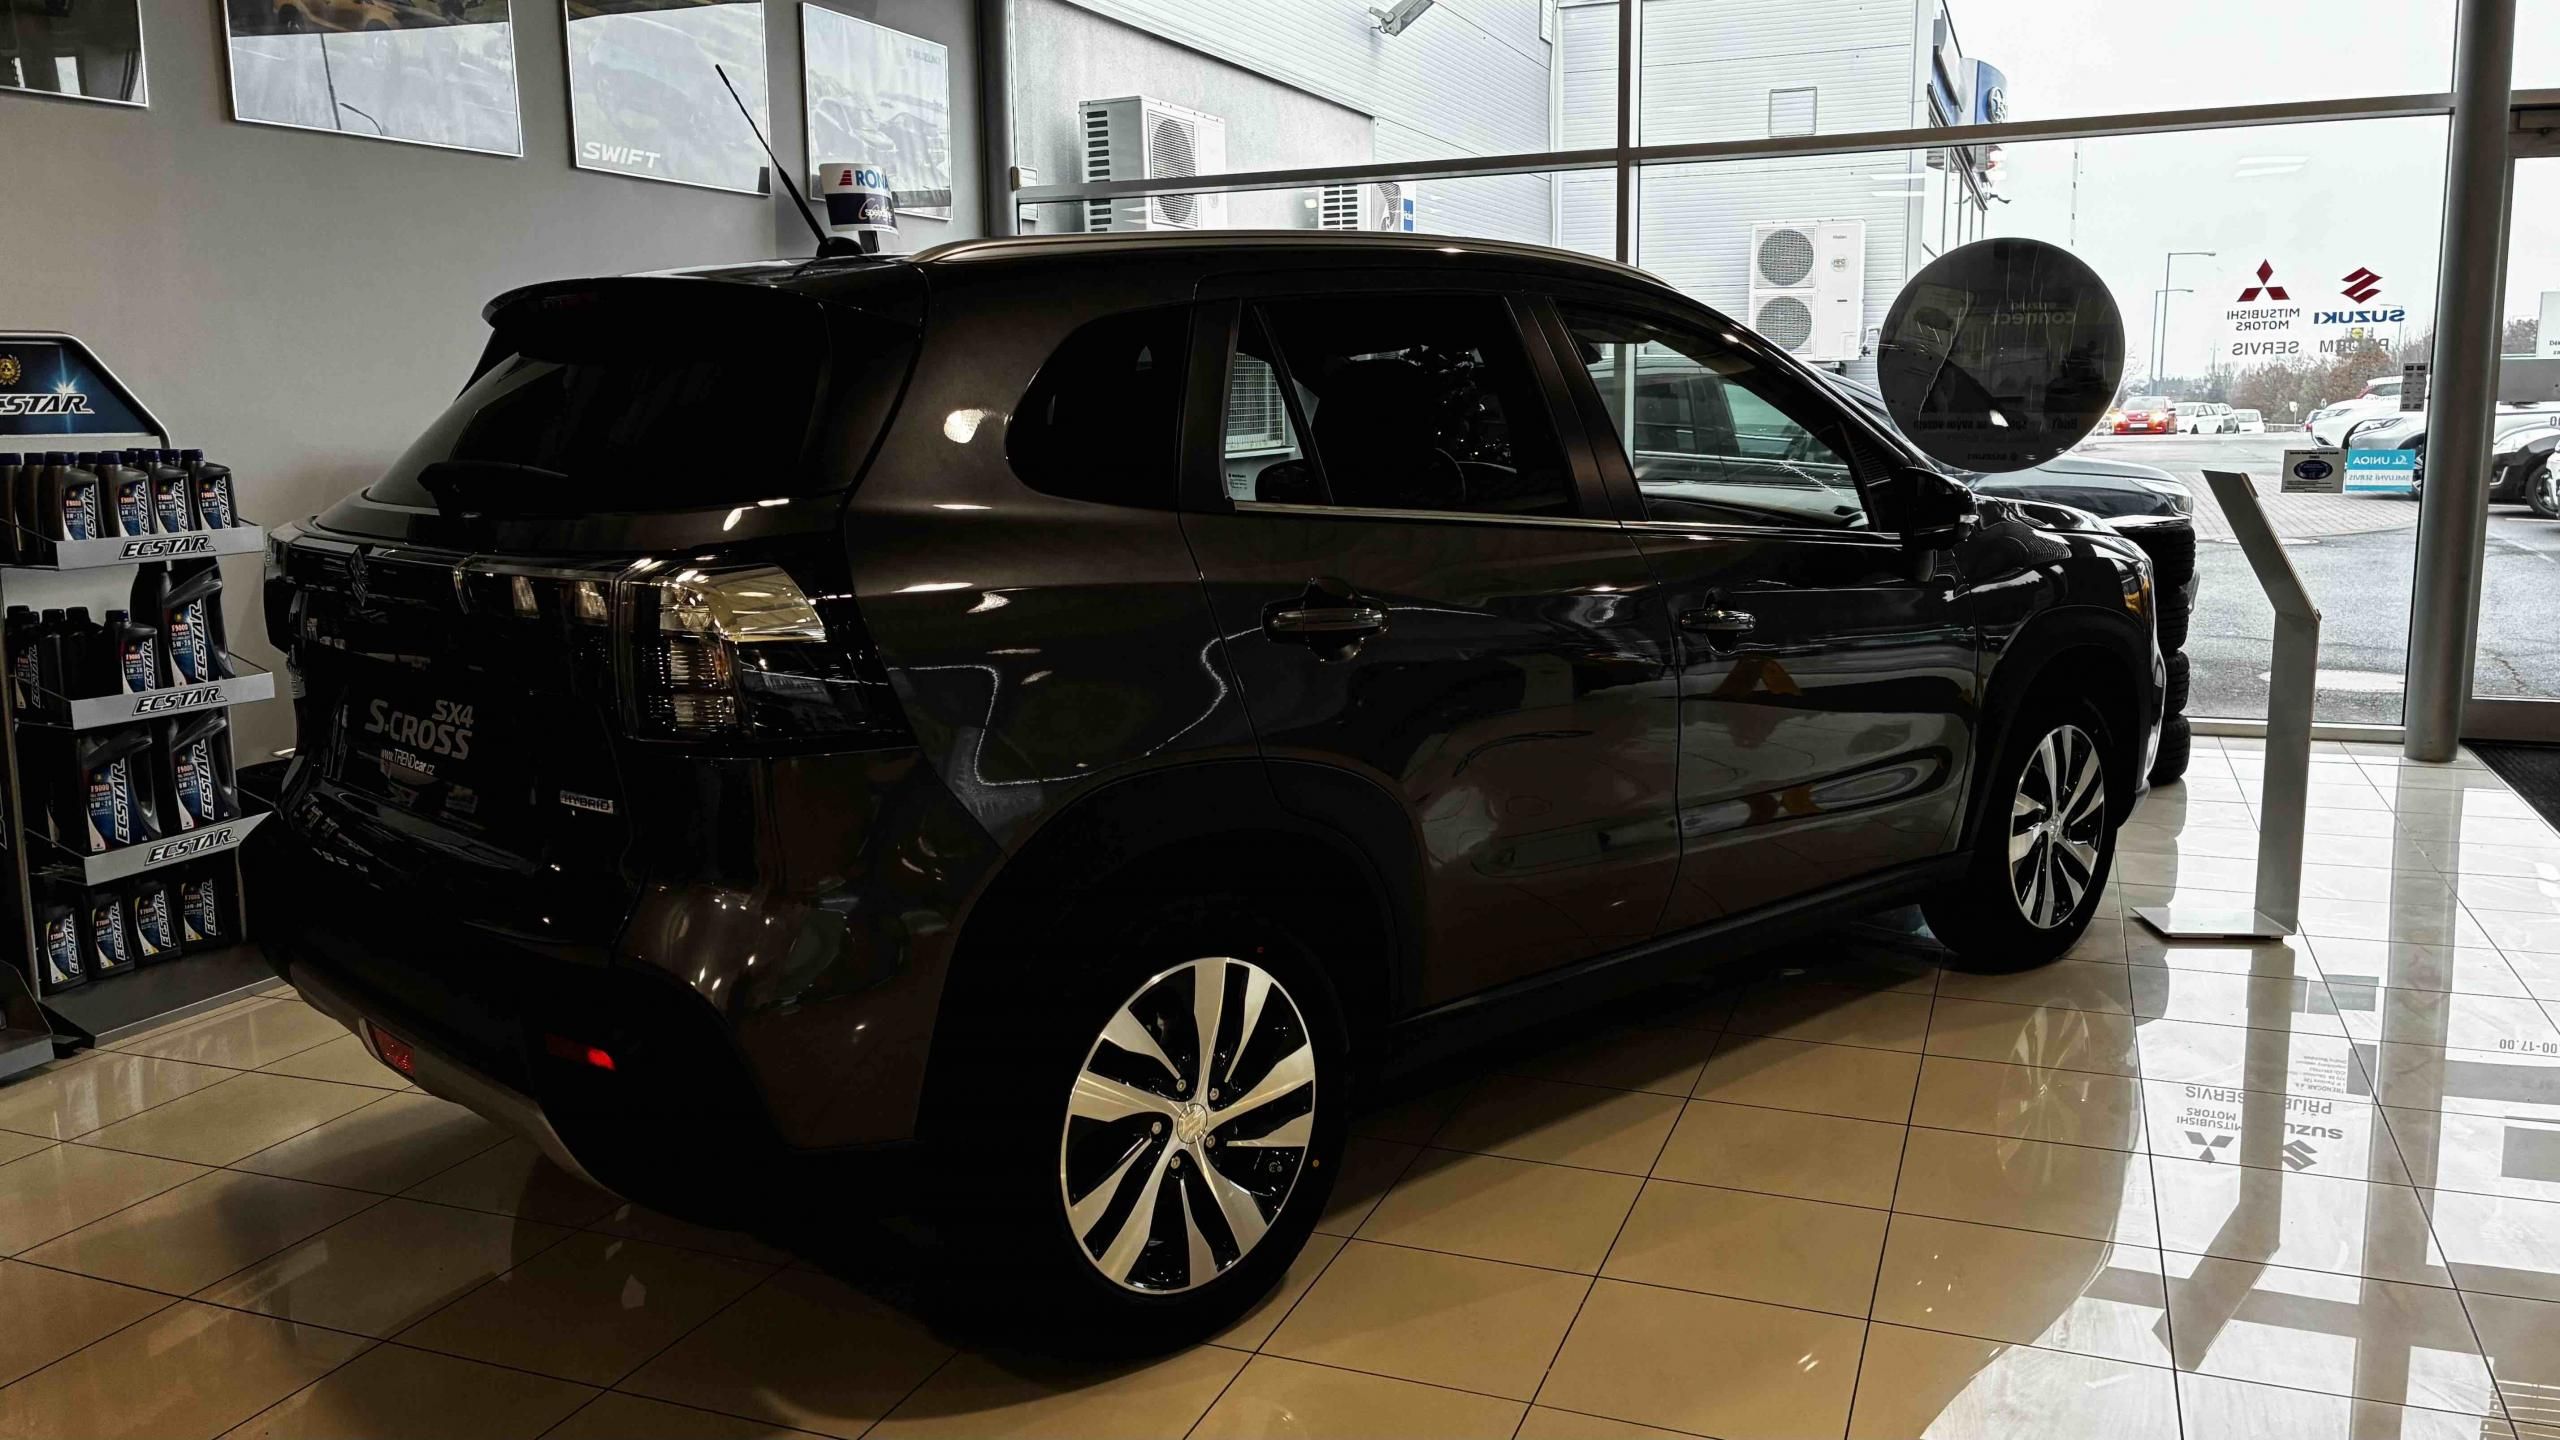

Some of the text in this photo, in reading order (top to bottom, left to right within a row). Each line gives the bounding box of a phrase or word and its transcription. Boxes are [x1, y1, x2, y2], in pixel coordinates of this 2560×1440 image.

[582, 141, 661, 169] SWIFT
[0, 393, 95, 415] STAR
[84, 483, 96, 540] CSTAR
[136, 481, 149, 536] CSTAR
[173, 479, 188, 532] CSTAR
[216, 475, 232, 529] CSTAR
[119, 535, 216, 560] ECSTAR
[188, 598, 208, 684] ECSTAR
[142, 638, 156, 692] CSTAR
[133, 686, 227, 716] ECSTAR
[432, 699, 474, 728] SX4
[110, 757, 130, 844] ECSTAR
[192, 738, 214, 820] ECSTAR
[561, 793, 609, 810] HYBRID
[145, 828, 239, 866] ECSTAR
[154, 890, 172, 948] ECSTAR
[201, 879, 217, 936] ECSTAR
[64, 913, 79, 974] ECSTAR
[109, 901, 126, 961] ECSTAR
[2185, 1085, 2245, 1104] SERVIS
[2186, 1107, 2236, 1121] MOTORS
[2285, 1097, 2332, 1116] PŘÍJE
[2176, 1115, 2242, 1131] MITSUBISHI
[2284, 1122, 2343, 1140] SUZU
